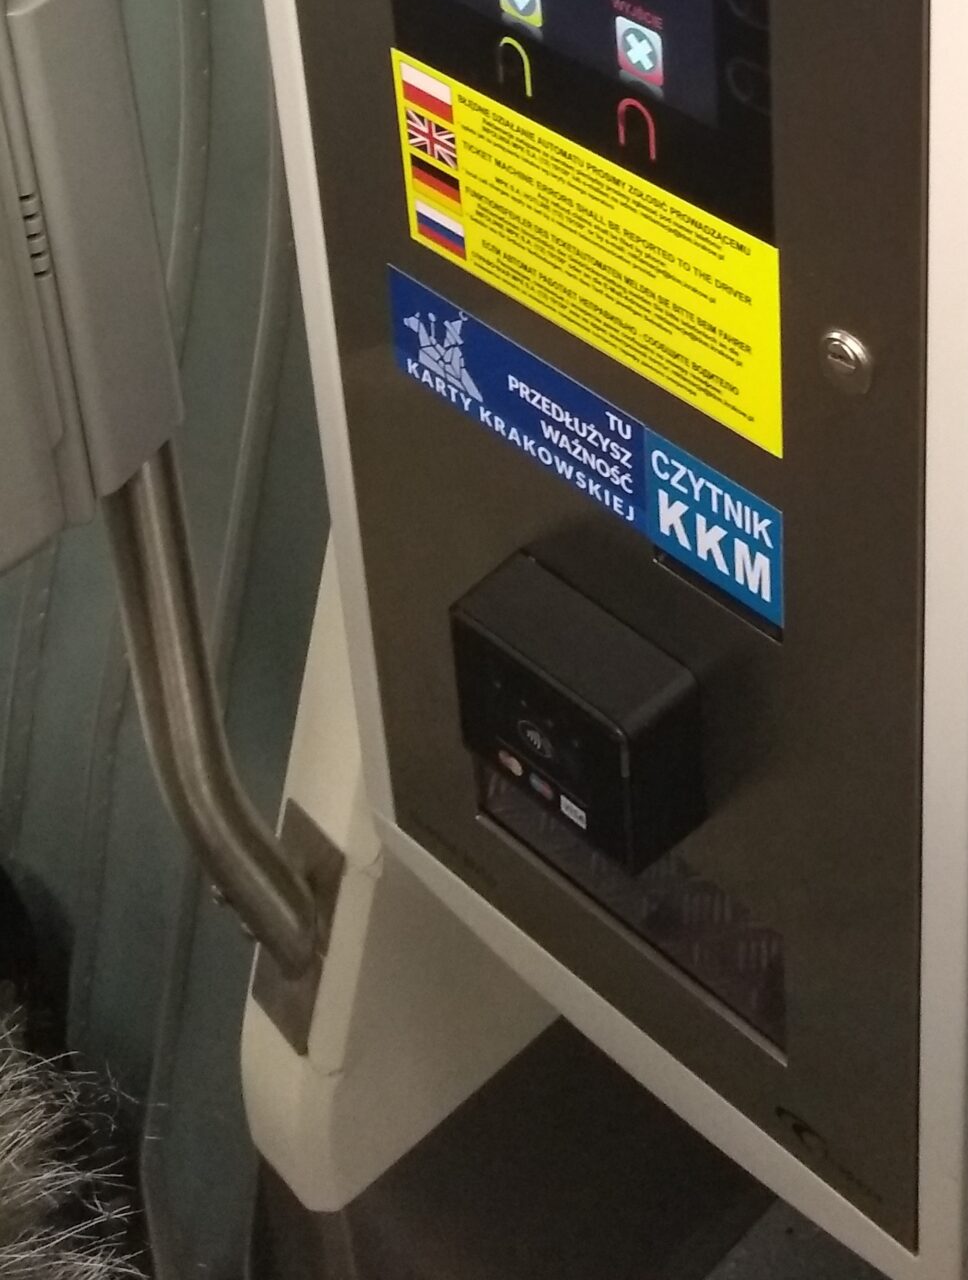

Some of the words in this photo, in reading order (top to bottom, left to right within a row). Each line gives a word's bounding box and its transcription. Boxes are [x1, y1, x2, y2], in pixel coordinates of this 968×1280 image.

[608, 219, 620, 234] BE
[623, 228, 674, 263] REPORTED
[677, 257, 690, 272] TO
[693, 266, 712, 284] THE
[715, 278, 751, 306] DRIVER
[406, 357, 473, 411] KARTY
[479, 406, 636, 523] KRAKOWSKIEJ
[507, 373, 633, 468] PRZEDŁUŻYSZ
[540, 419, 634, 495] WAŻNOŚĆ
[604, 411, 632, 440] TU
[651, 450, 773, 549] CZYTNIK
[657, 488, 772, 603] KKM
